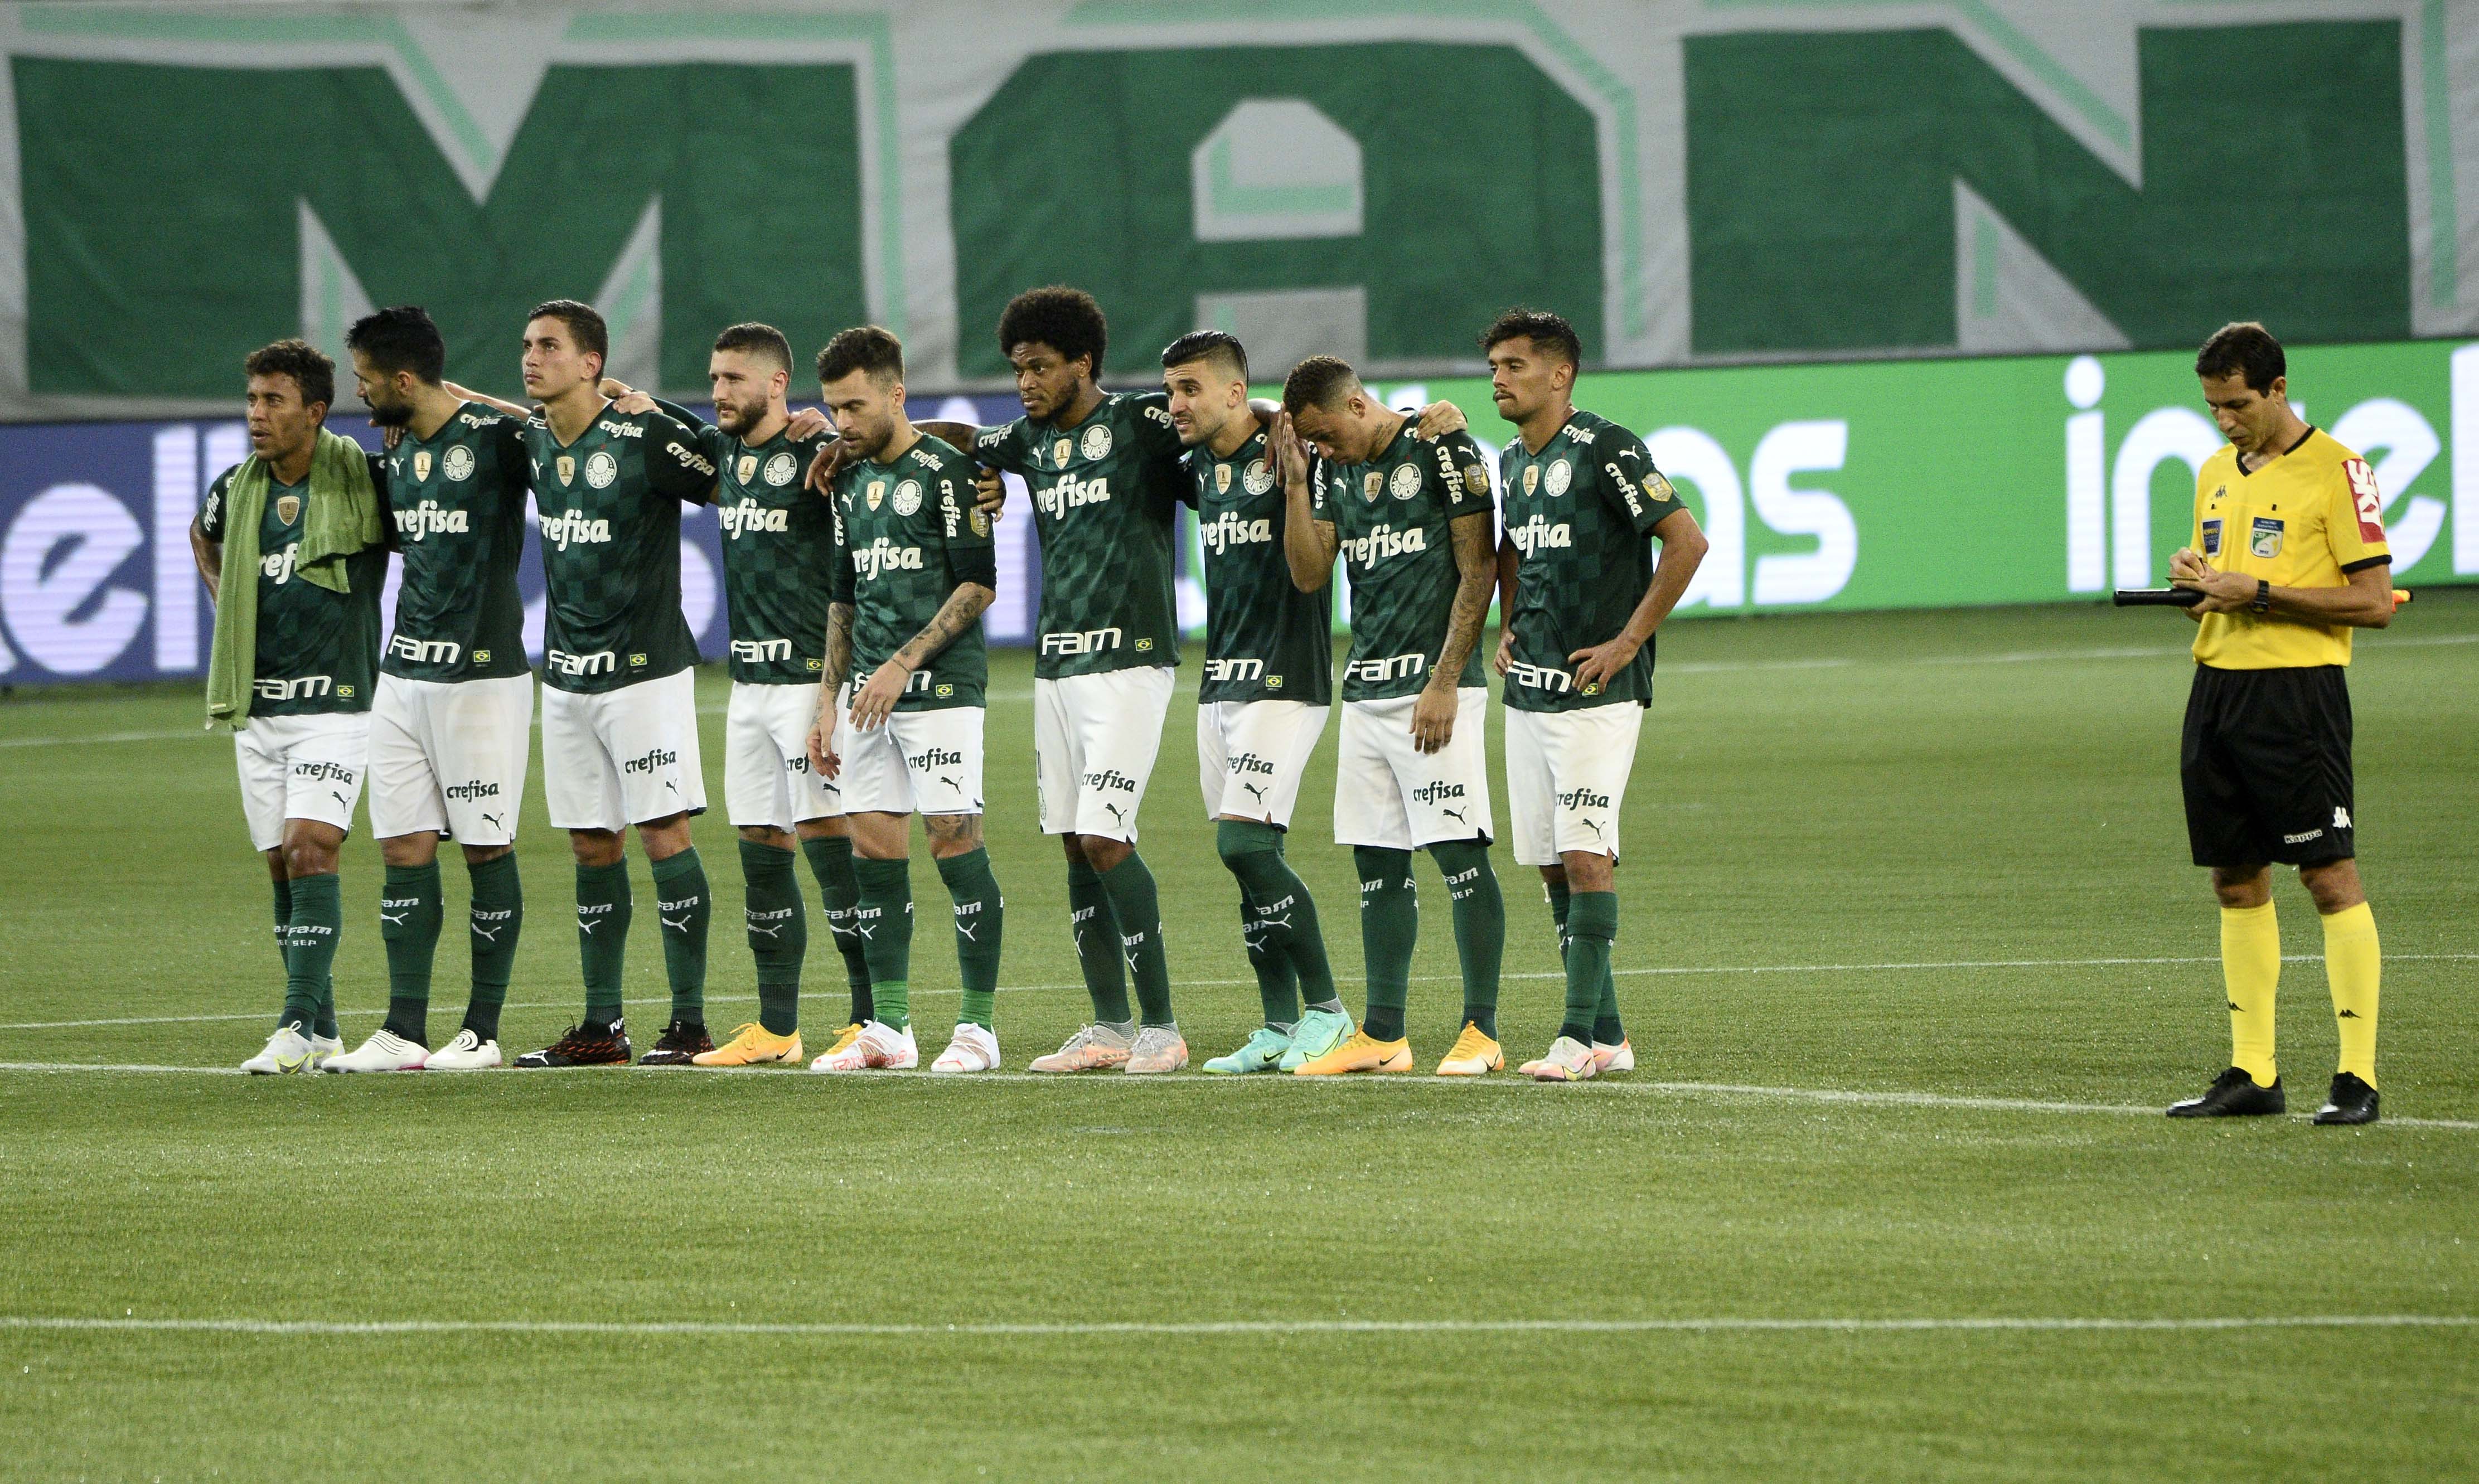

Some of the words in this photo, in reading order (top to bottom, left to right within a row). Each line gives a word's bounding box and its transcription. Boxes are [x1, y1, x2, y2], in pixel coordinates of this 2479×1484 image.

[599, 420, 644, 438] crefisa
[666, 442, 716, 477] crefisa
[910, 449, 944, 472] crefisa
[1435, 446, 1463, 504] crefisa
[940, 479, 961, 538] crefisa
[1605, 463, 1643, 518] crefisa
[393, 500, 469, 541] refisa
[719, 498, 788, 540] refisa
[1201, 511, 1272, 556] refisa
[852, 537, 923, 581] refisa
[295, 762, 354, 785] crefisa
[624, 748, 677, 774] crefisa
[446, 779, 500, 803] crefisa
